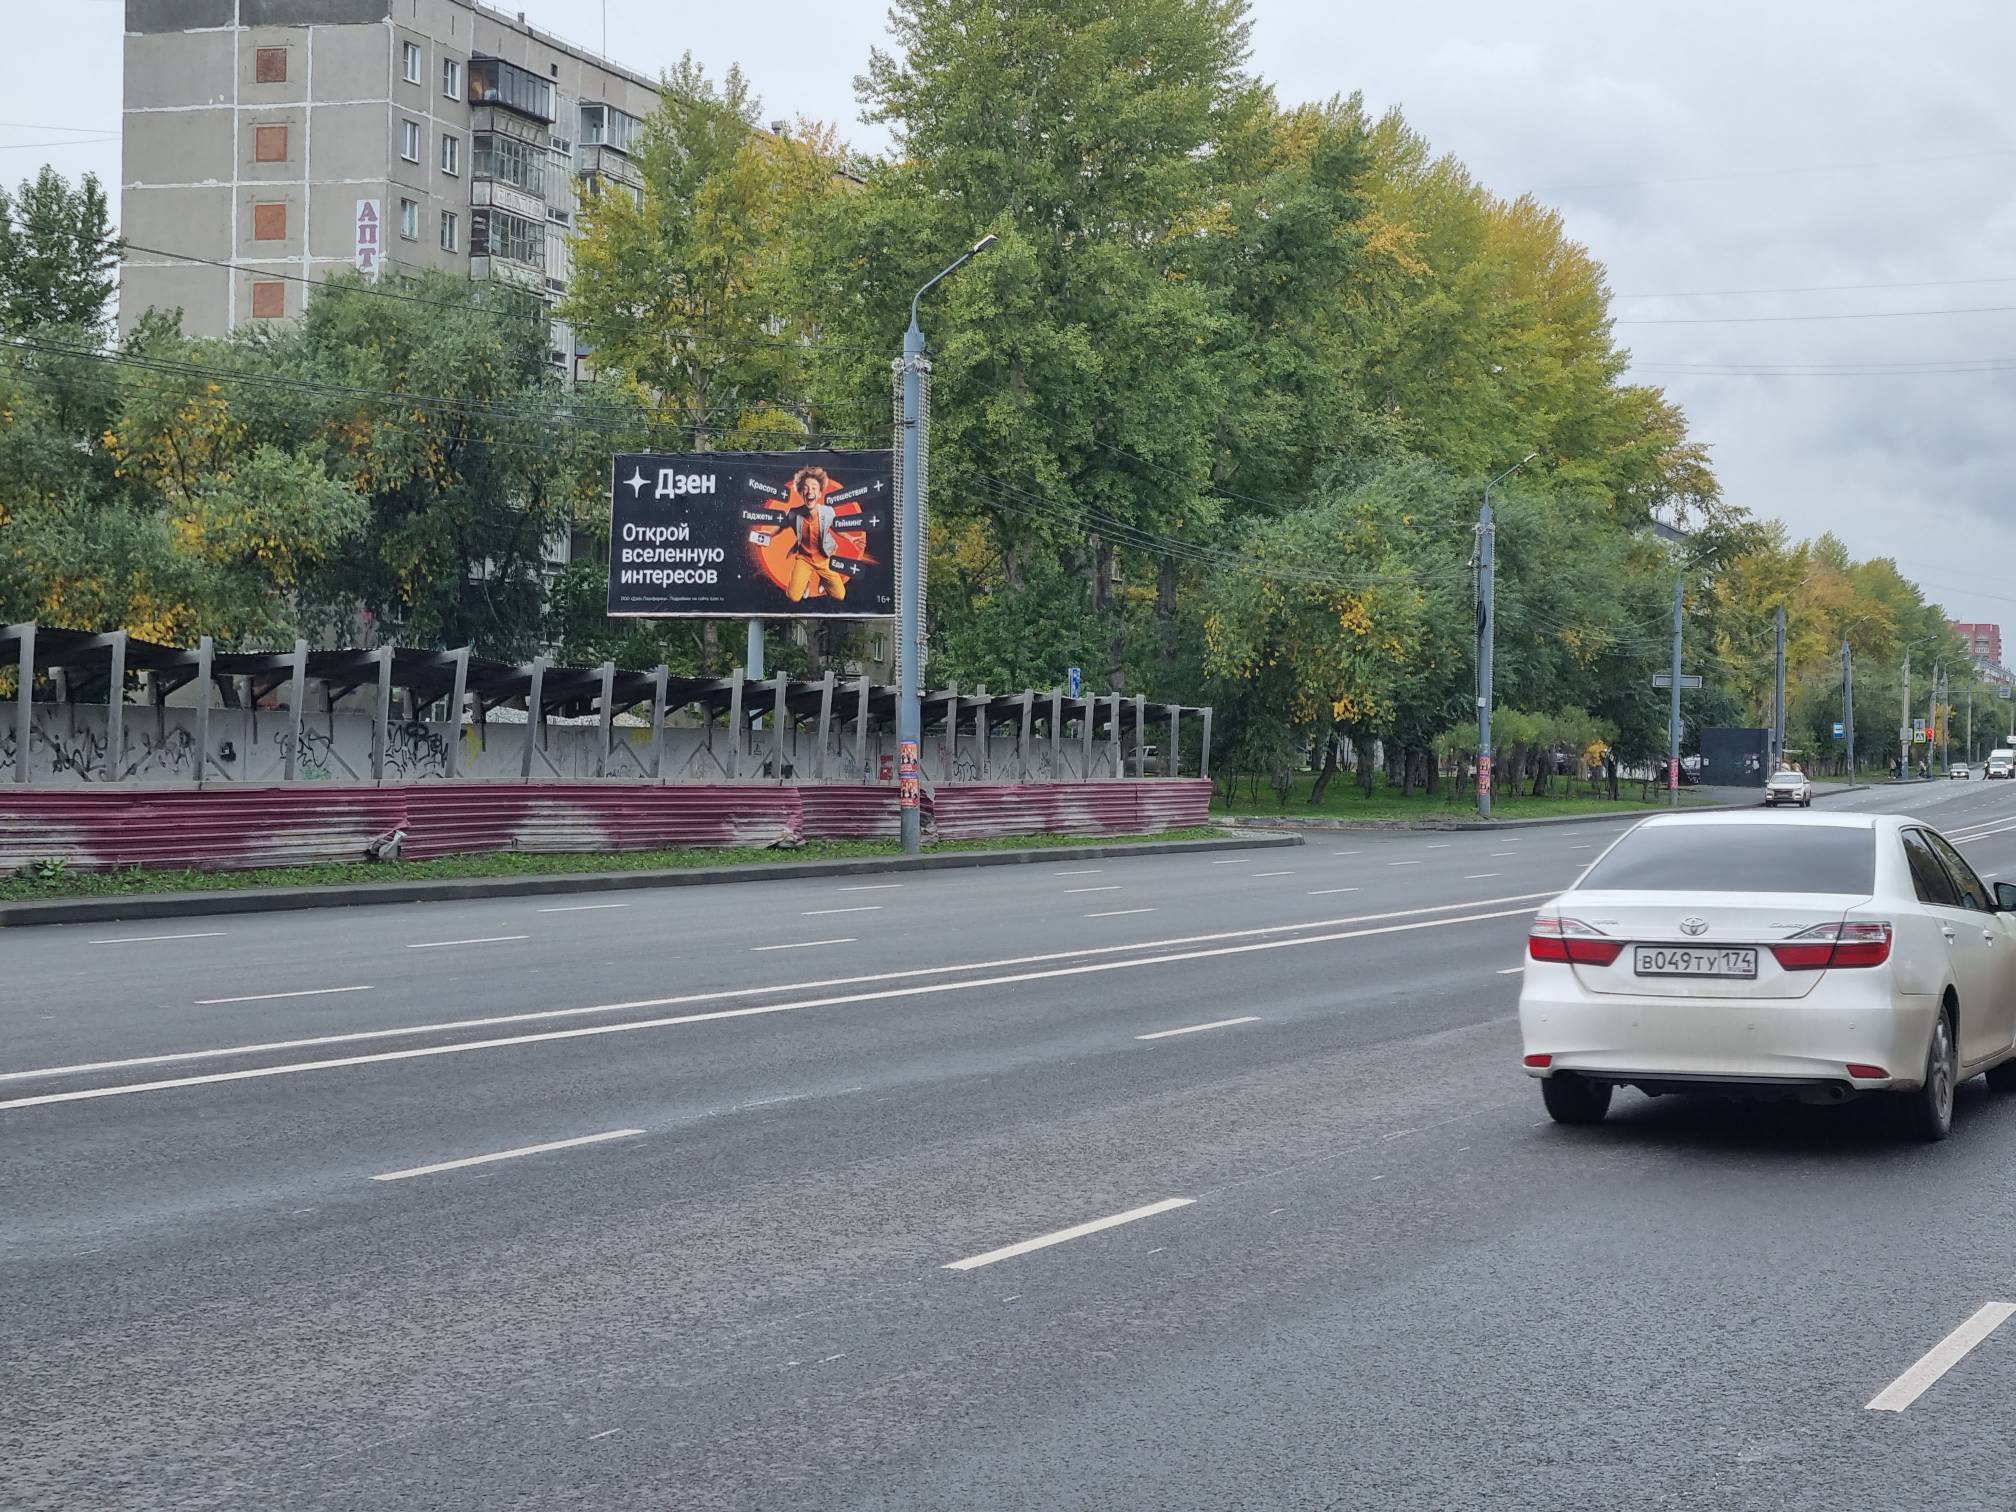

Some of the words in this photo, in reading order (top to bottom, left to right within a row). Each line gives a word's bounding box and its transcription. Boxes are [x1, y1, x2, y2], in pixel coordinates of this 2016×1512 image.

[655, 468, 716, 499] Дзен
[748, 478, 778, 495] Красота
[826, 486, 868, 505] Путешествия
[742, 510, 773, 521] Гаджеты
[835, 519, 863, 528] Гейминг
[623, 523, 690, 545] Открой
[622, 548, 725, 567] вселенную
[831, 559, 845, 570] Еда
[621, 569, 718, 588] интересов
[876, 595, 891, 604] 16+
